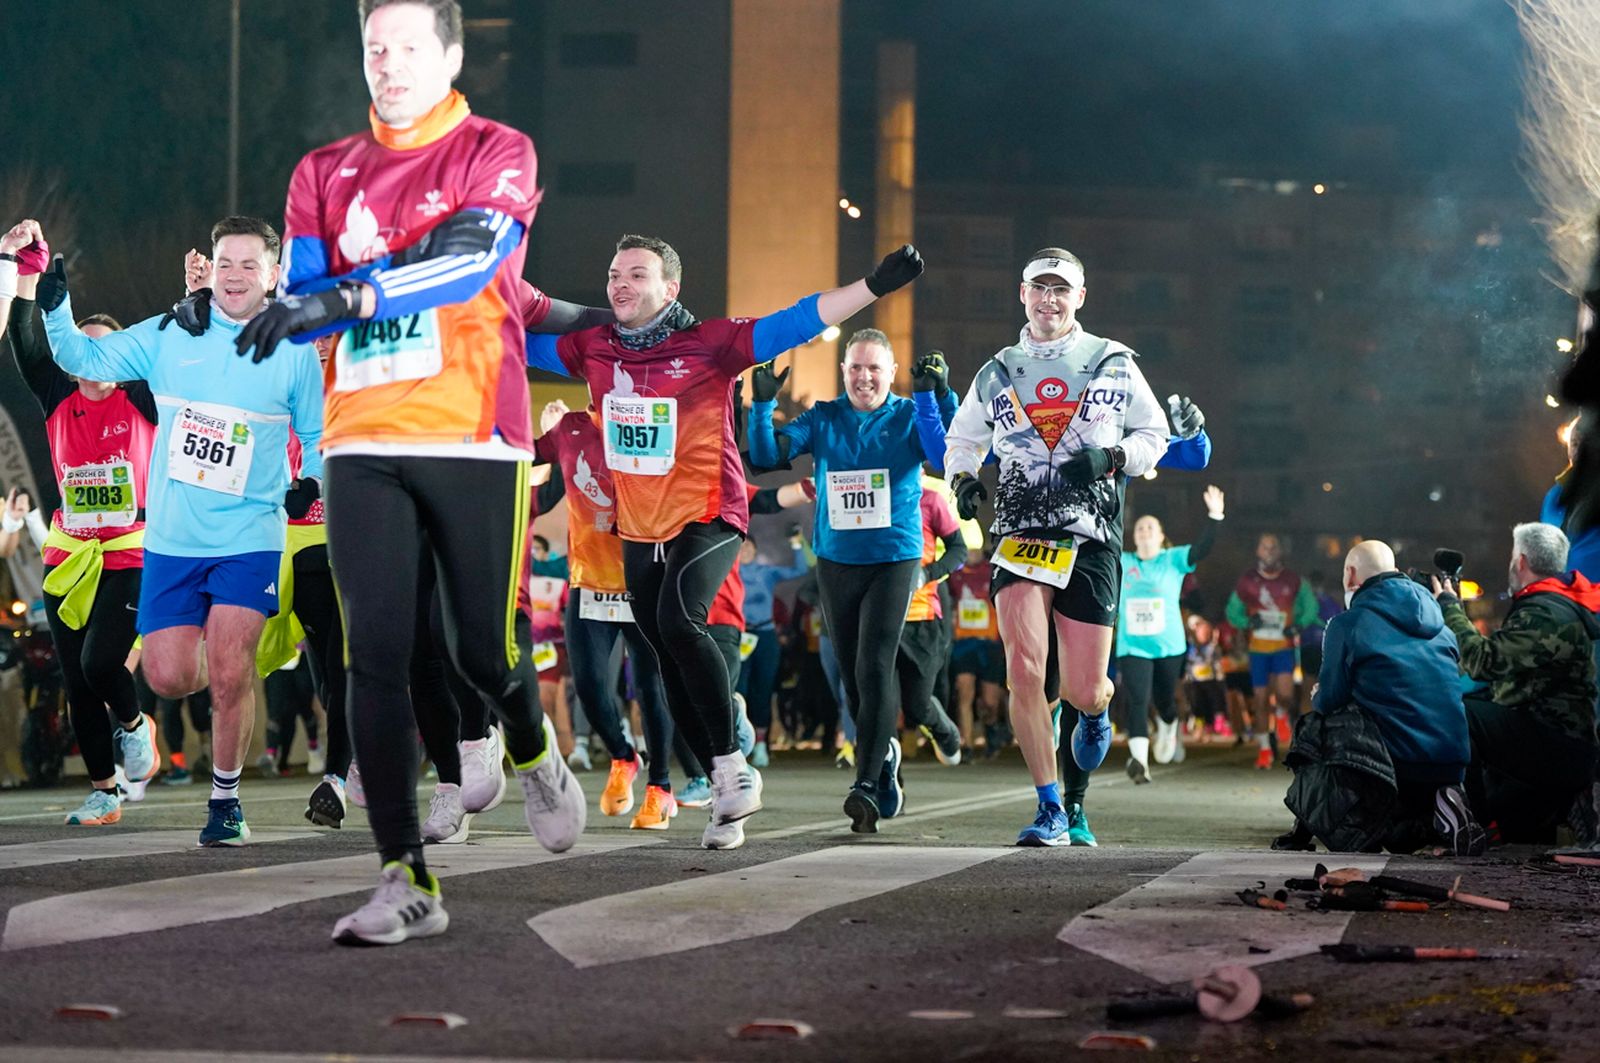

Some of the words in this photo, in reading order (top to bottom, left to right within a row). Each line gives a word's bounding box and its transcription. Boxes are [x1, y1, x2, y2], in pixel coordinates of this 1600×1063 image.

[635, 405, 645, 414] DE
[182, 420, 197, 433] SAN
[194, 414, 215, 428] NOCHE
[216, 421, 227, 431] DE
[616, 424, 659, 449] 7957
[183, 432, 236, 467] 5361
[74, 485, 123, 506] 2083
[584, 481, 599, 499] 43
[841, 490, 875, 509] 1701
[1013, 543, 1060, 565] 2011
